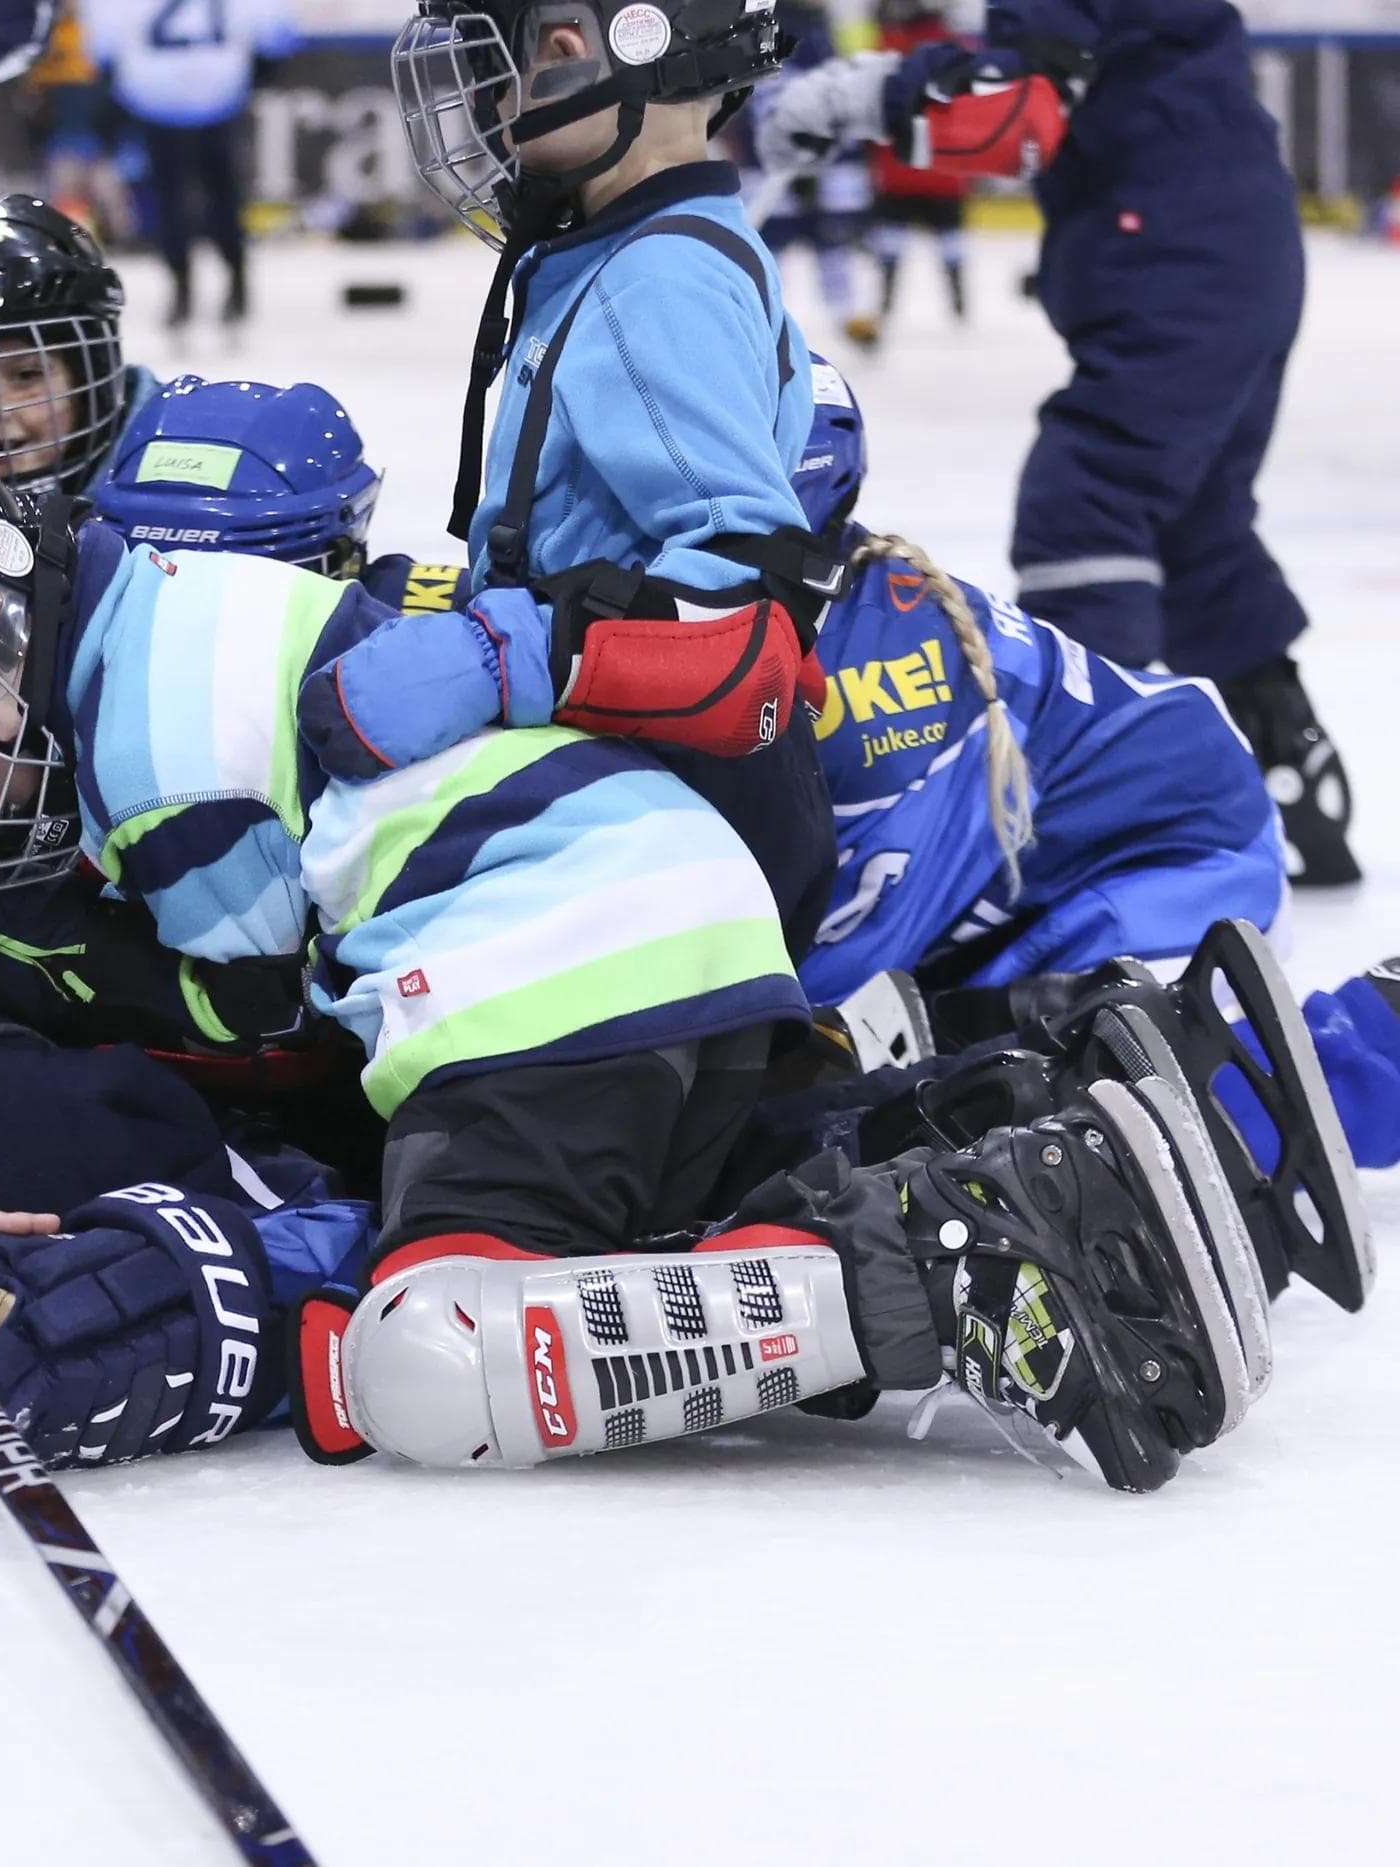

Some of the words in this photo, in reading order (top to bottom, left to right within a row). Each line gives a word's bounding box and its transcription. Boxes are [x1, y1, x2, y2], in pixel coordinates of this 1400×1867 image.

[153, 456, 204, 472] LUISA
[130, 525, 221, 543] BAUER
[813, 639, 953, 741] UKE!
[100, 1182, 260, 1447] BAUER
[534, 1326, 569, 1437] CCM
